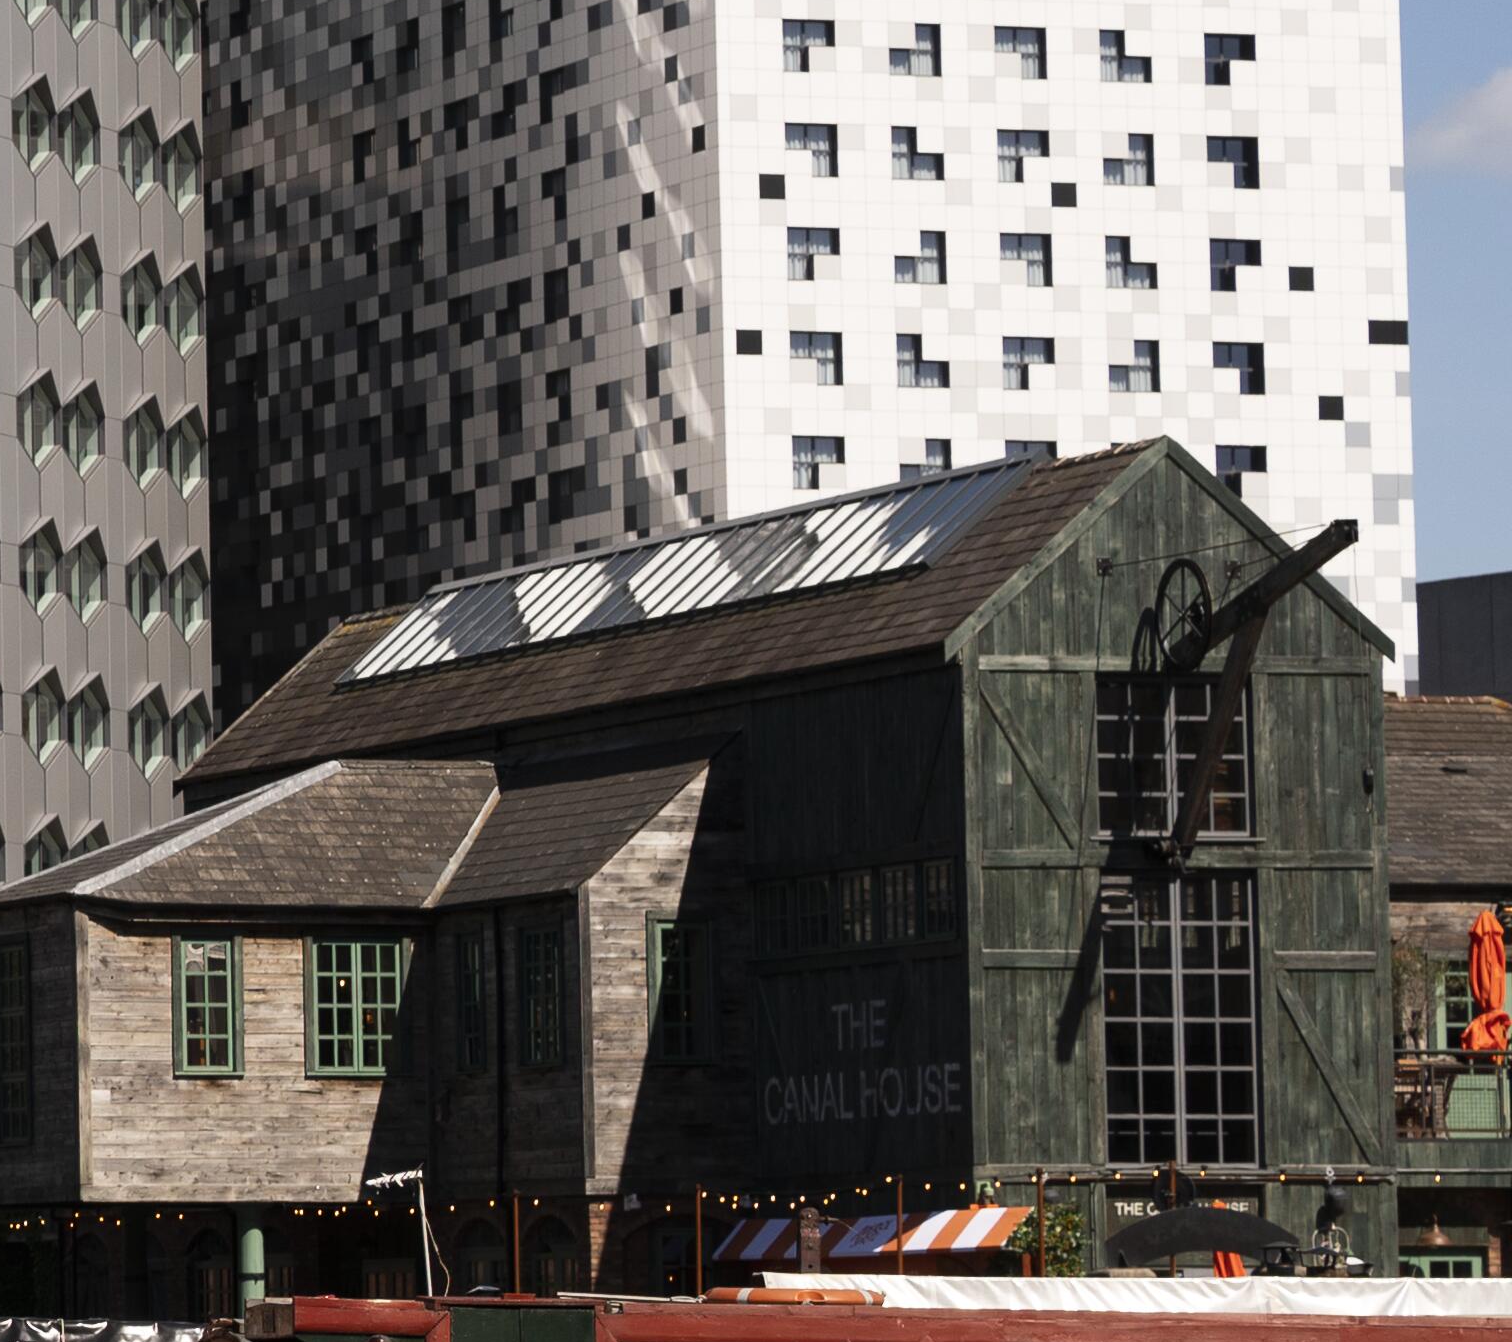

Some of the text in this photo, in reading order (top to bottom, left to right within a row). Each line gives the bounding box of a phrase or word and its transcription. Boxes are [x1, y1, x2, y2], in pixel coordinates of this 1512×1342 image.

[831, 999, 886, 1051] THE
[764, 1063, 963, 1126] CANAL HOUSE
[1114, 1201, 1145, 1216] THE
